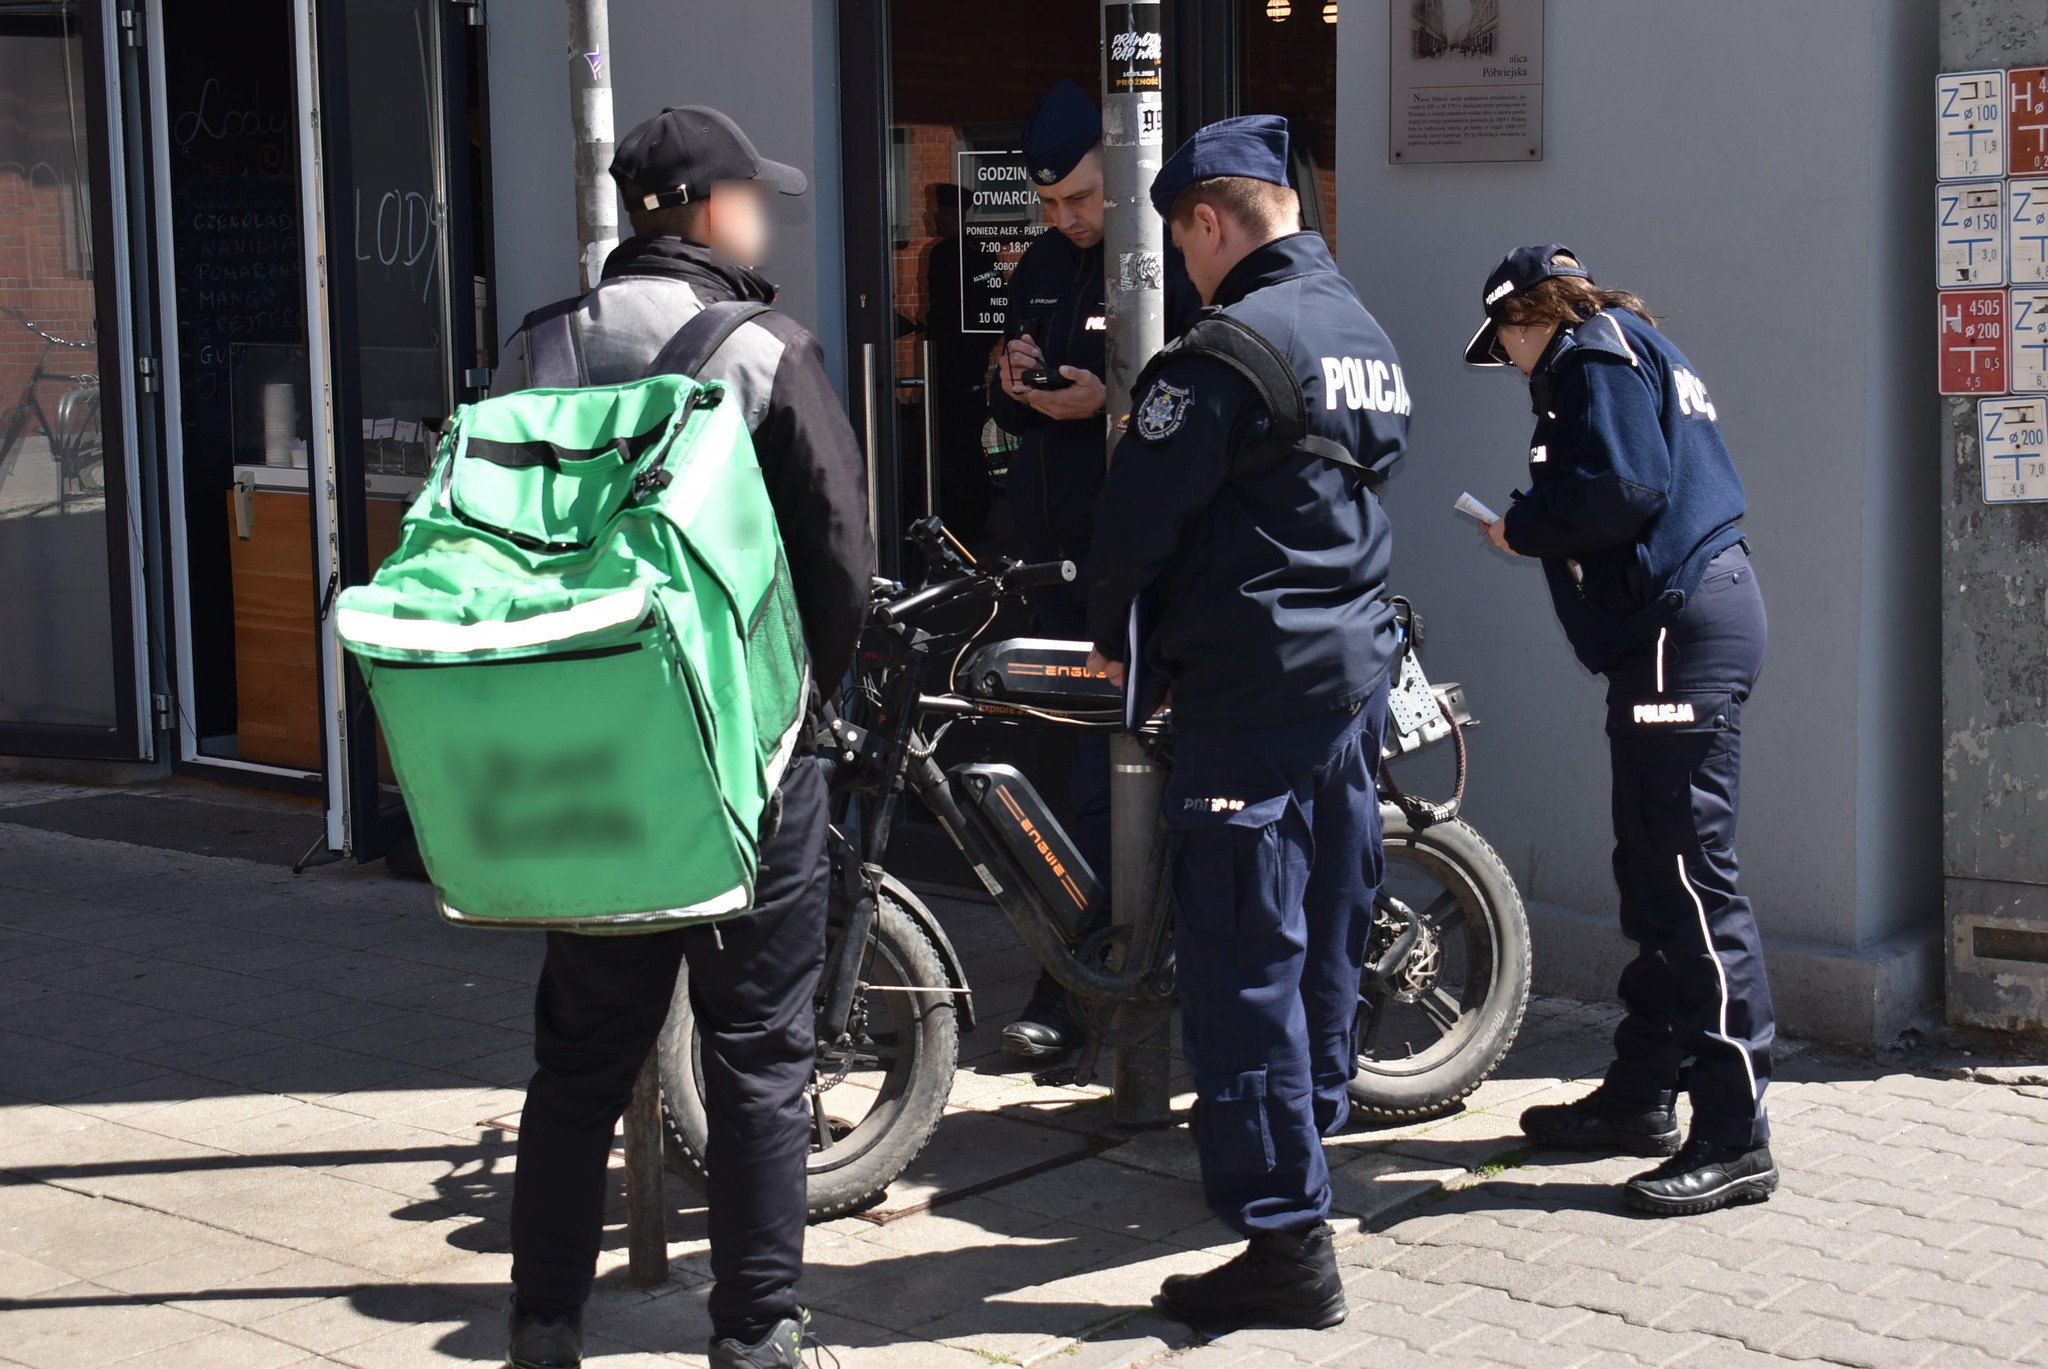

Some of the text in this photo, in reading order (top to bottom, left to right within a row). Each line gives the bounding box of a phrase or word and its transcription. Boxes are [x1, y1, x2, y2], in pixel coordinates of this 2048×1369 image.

[1111, 46, 1136, 61] RAP
[1510, 54, 1527, 63] ulica
[1483, 67, 1527, 79] Półwiejska
[1941, 88, 1960, 118] Z
[2011, 76, 2048, 113] H 4
[1977, 104, 1997, 121] 100
[978, 167, 1031, 181] GODZIN
[973, 190, 1041, 205] OTWARCIA
[1941, 197, 1959, 226] Z
[2013, 192, 2031, 221] Z
[1977, 213, 1997, 230] 150
[966, 226, 998, 235] PONIEDZ
[1000, 226, 1018, 235] AŁEK
[200, 235, 295, 257] WANILIA
[980, 242, 1001, 253] 7:00
[200, 287, 275, 309] MANGO
[1969, 299, 2000, 316] 4505
[2014, 301, 2033, 331] Z
[1978, 322, 2000, 339] 200
[1984, 412, 2004, 441] Z
[2021, 429, 2043, 445] 200
[1633, 704, 1695, 723] POLICJA
